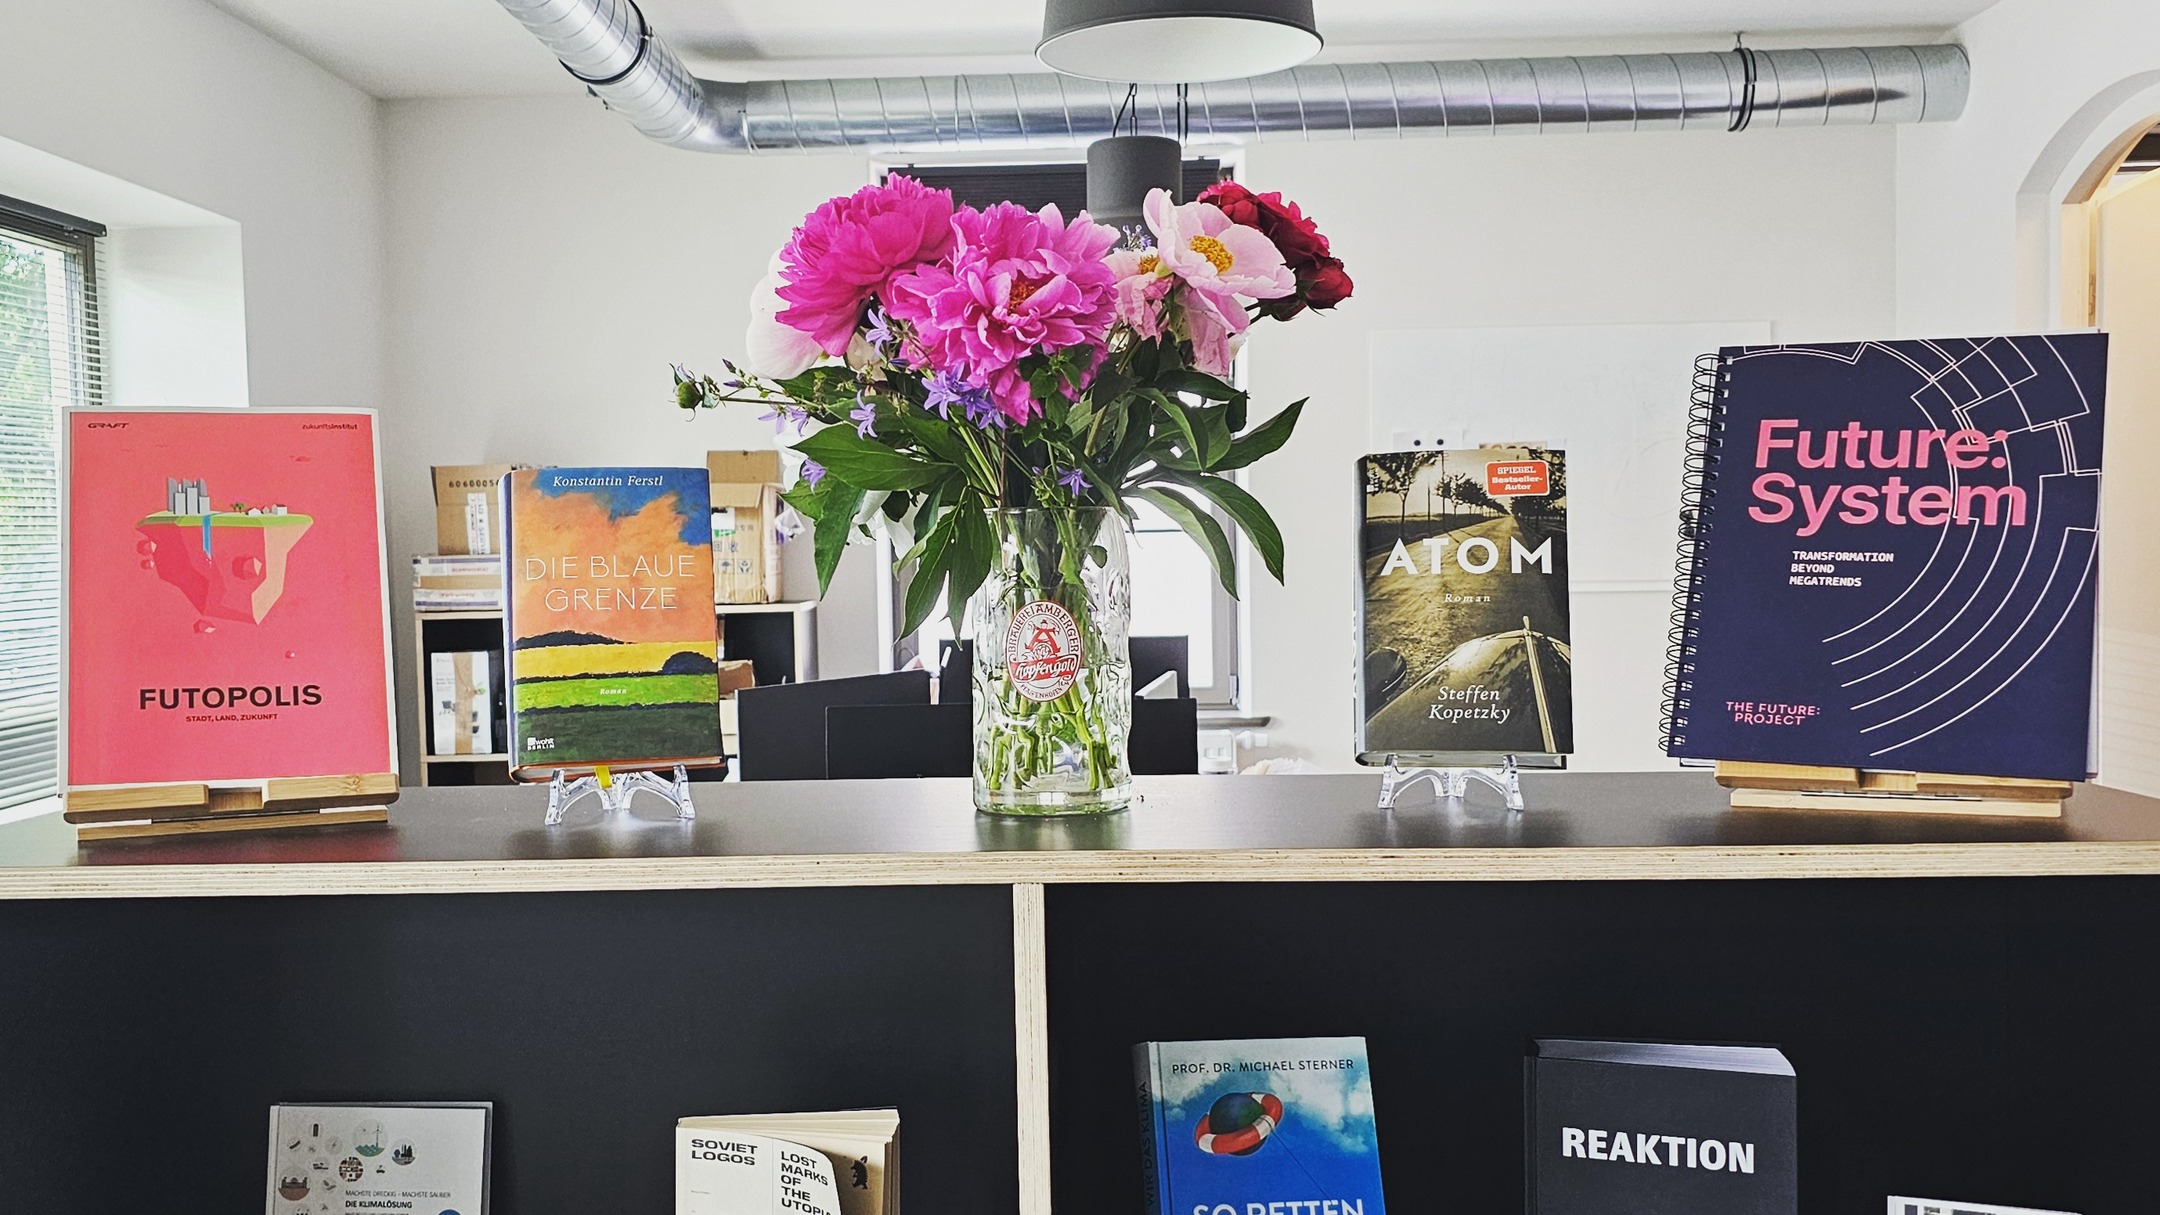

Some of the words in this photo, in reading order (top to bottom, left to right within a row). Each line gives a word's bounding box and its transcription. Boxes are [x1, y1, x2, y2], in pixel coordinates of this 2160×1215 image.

[1754, 419, 2009, 469] Future:
[1497, 465, 1536, 475] SPIEGEL
[552, 475, 624, 488] Konstantin
[627, 474, 664, 487] Ferstl
[1491, 475, 1543, 484] Bestseller-
[1504, 483, 1532, 491] Autor
[1748, 472, 2027, 537] System
[1379, 536, 1554, 577] ATOM
[1792, 550, 1895, 563] TRANSFORMATION
[524, 555, 579, 581] DIE
[590, 553, 696, 578] BLAUE
[1790, 563, 1836, 574] BEYOND
[1788, 575, 1863, 588] MEGATRENDS
[544, 586, 678, 612] GRENZE
[1444, 592, 1491, 604] Roman
[1008, 605, 1035, 653] BRAUEREI
[1036, 603, 1080, 653] AMBERGER
[139, 684, 323, 710] FUTOPOLIS
[1437, 685, 1501, 704] Steffen
[240, 713, 279, 721] ZUKUNFT
[1428, 704, 1511, 724] Kopetzky
[1726, 702, 1754, 713] THE
[1758, 703, 1821, 716] FUTURE:
[1734, 712, 1806, 725] PROJECT
[1172, 1064, 1209, 1074] PROF.
[1213, 1062, 1235, 1073] DR.
[1239, 1061, 1294, 1072] MICHAEL
[1299, 1060, 1354, 1070] STERNER
[1139, 1081, 1150, 1133] KLIMA
[691, 1139, 758, 1155] SOVIET
[1142, 1137, 1153, 1170] DAS
[1562, 1127, 1755, 1174] REAKTION
[691, 1151, 755, 1166] LOGOS
[781, 1151, 817, 1169] LOST
[780, 1174, 801, 1186] OF
[781, 1163, 828, 1186] MARKS
[781, 1186, 811, 1202] THE
[345, 1200, 357, 1208] DIE
[358, 1200, 413, 1208] KLIMALÖSUNG
